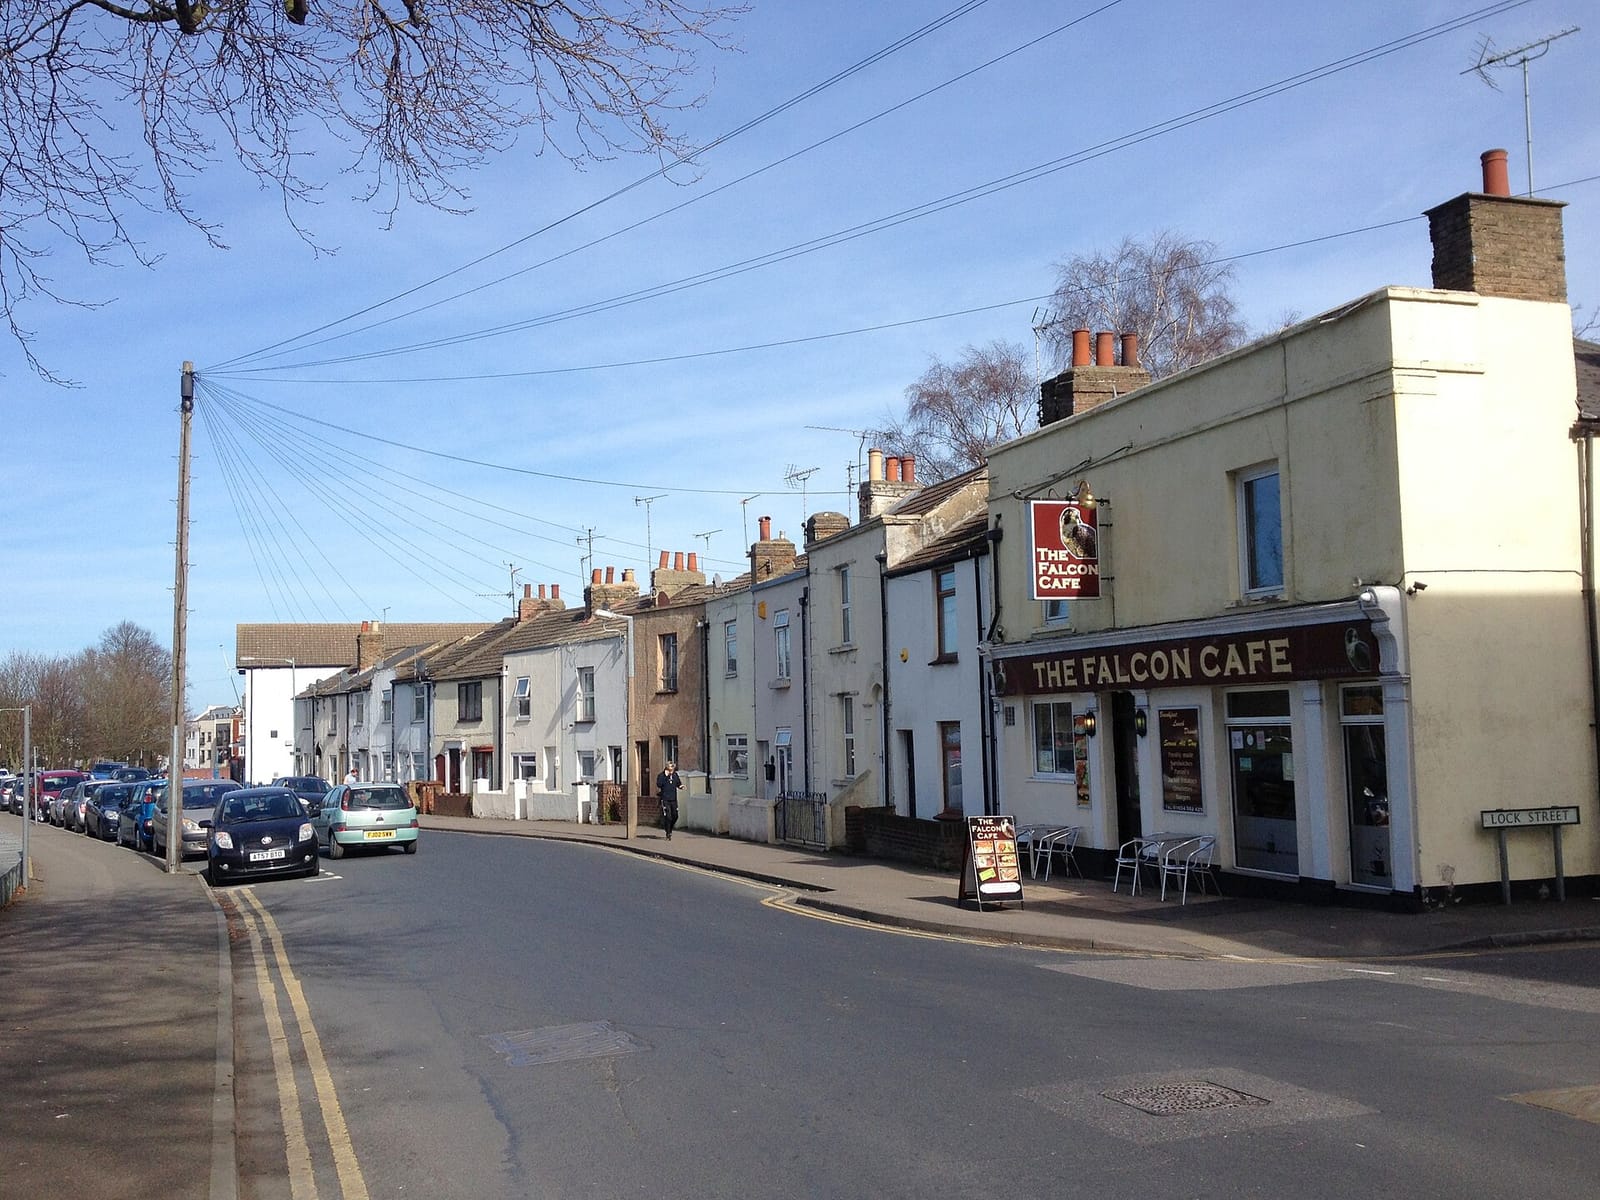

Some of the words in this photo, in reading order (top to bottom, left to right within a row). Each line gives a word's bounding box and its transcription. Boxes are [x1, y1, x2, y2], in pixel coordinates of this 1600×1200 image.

[1037, 547, 1069, 561] THE
[1038, 562, 1098, 575] FALCON
[1038, 576, 1081, 589] CAFE
[1032, 658, 1079, 688] THE
[1082, 647, 1193, 685] FALCON
[1199, 637, 1293, 678] CAFE
[1491, 812, 1520, 825] LOCK
[1528, 810, 1569, 822] STREET
[972, 825, 1002, 833] FALCON
